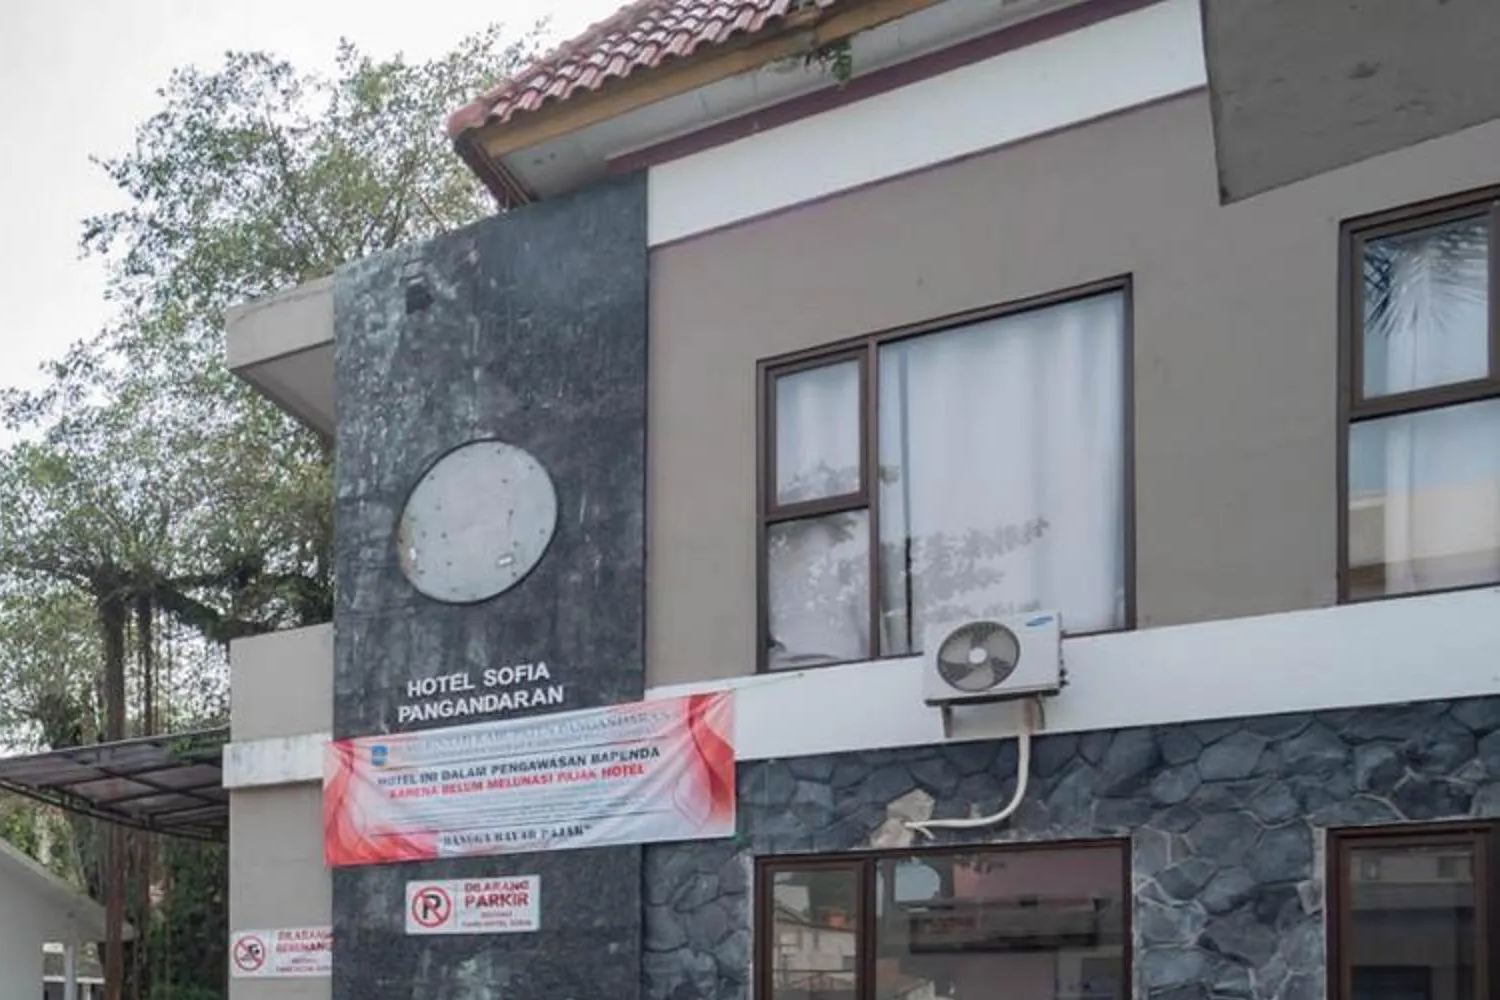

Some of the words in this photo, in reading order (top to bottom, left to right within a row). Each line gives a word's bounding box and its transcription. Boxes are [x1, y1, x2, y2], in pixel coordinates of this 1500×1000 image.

[407, 672, 475, 697] HOTEL
[483, 661, 550, 687] SOFIA
[398, 685, 564, 723] PANGANDARAN
[441, 766, 487, 781] DALAM
[491, 755, 587, 775] PENGAWASAN
[601, 762, 644, 778] HOTEL
[464, 892, 529, 909] PARKIR
